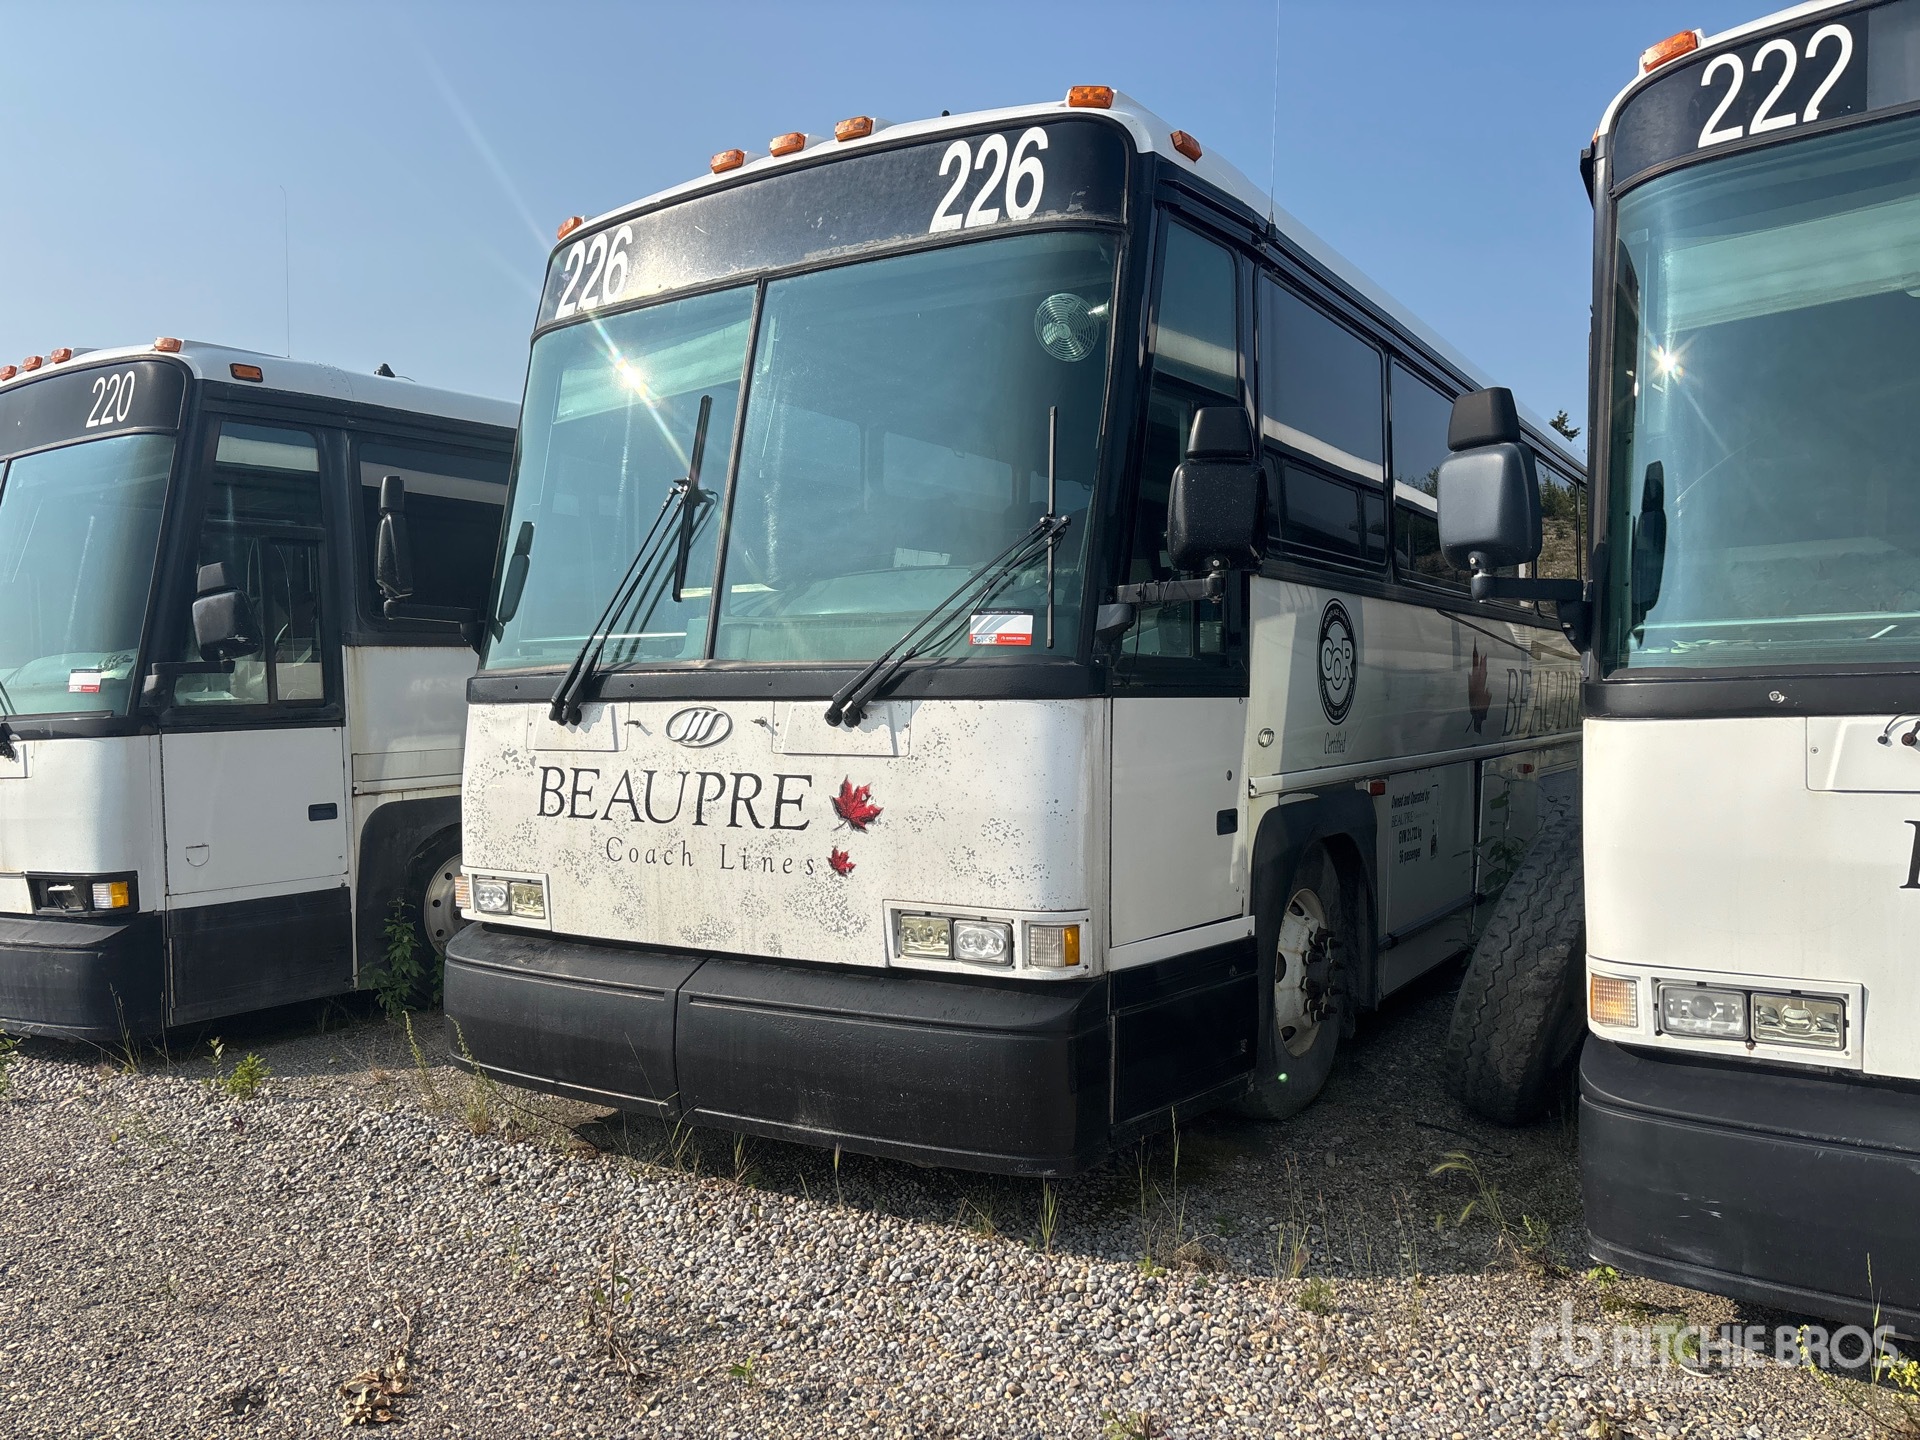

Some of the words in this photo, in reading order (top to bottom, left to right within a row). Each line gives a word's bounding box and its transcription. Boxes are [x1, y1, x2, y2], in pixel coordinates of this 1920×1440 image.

[1698, 24, 1853, 148] 222
[929, 126, 1049, 234] 226
[555, 224, 633, 320] 226
[85, 370, 135, 428] 220
[1321, 637, 1354, 690] COR
[1324, 730, 1347, 754] Certified
[537, 765, 813, 832] BEAUPRE
[605, 836, 694, 867] Coach
[719, 843, 815, 876] Lines
